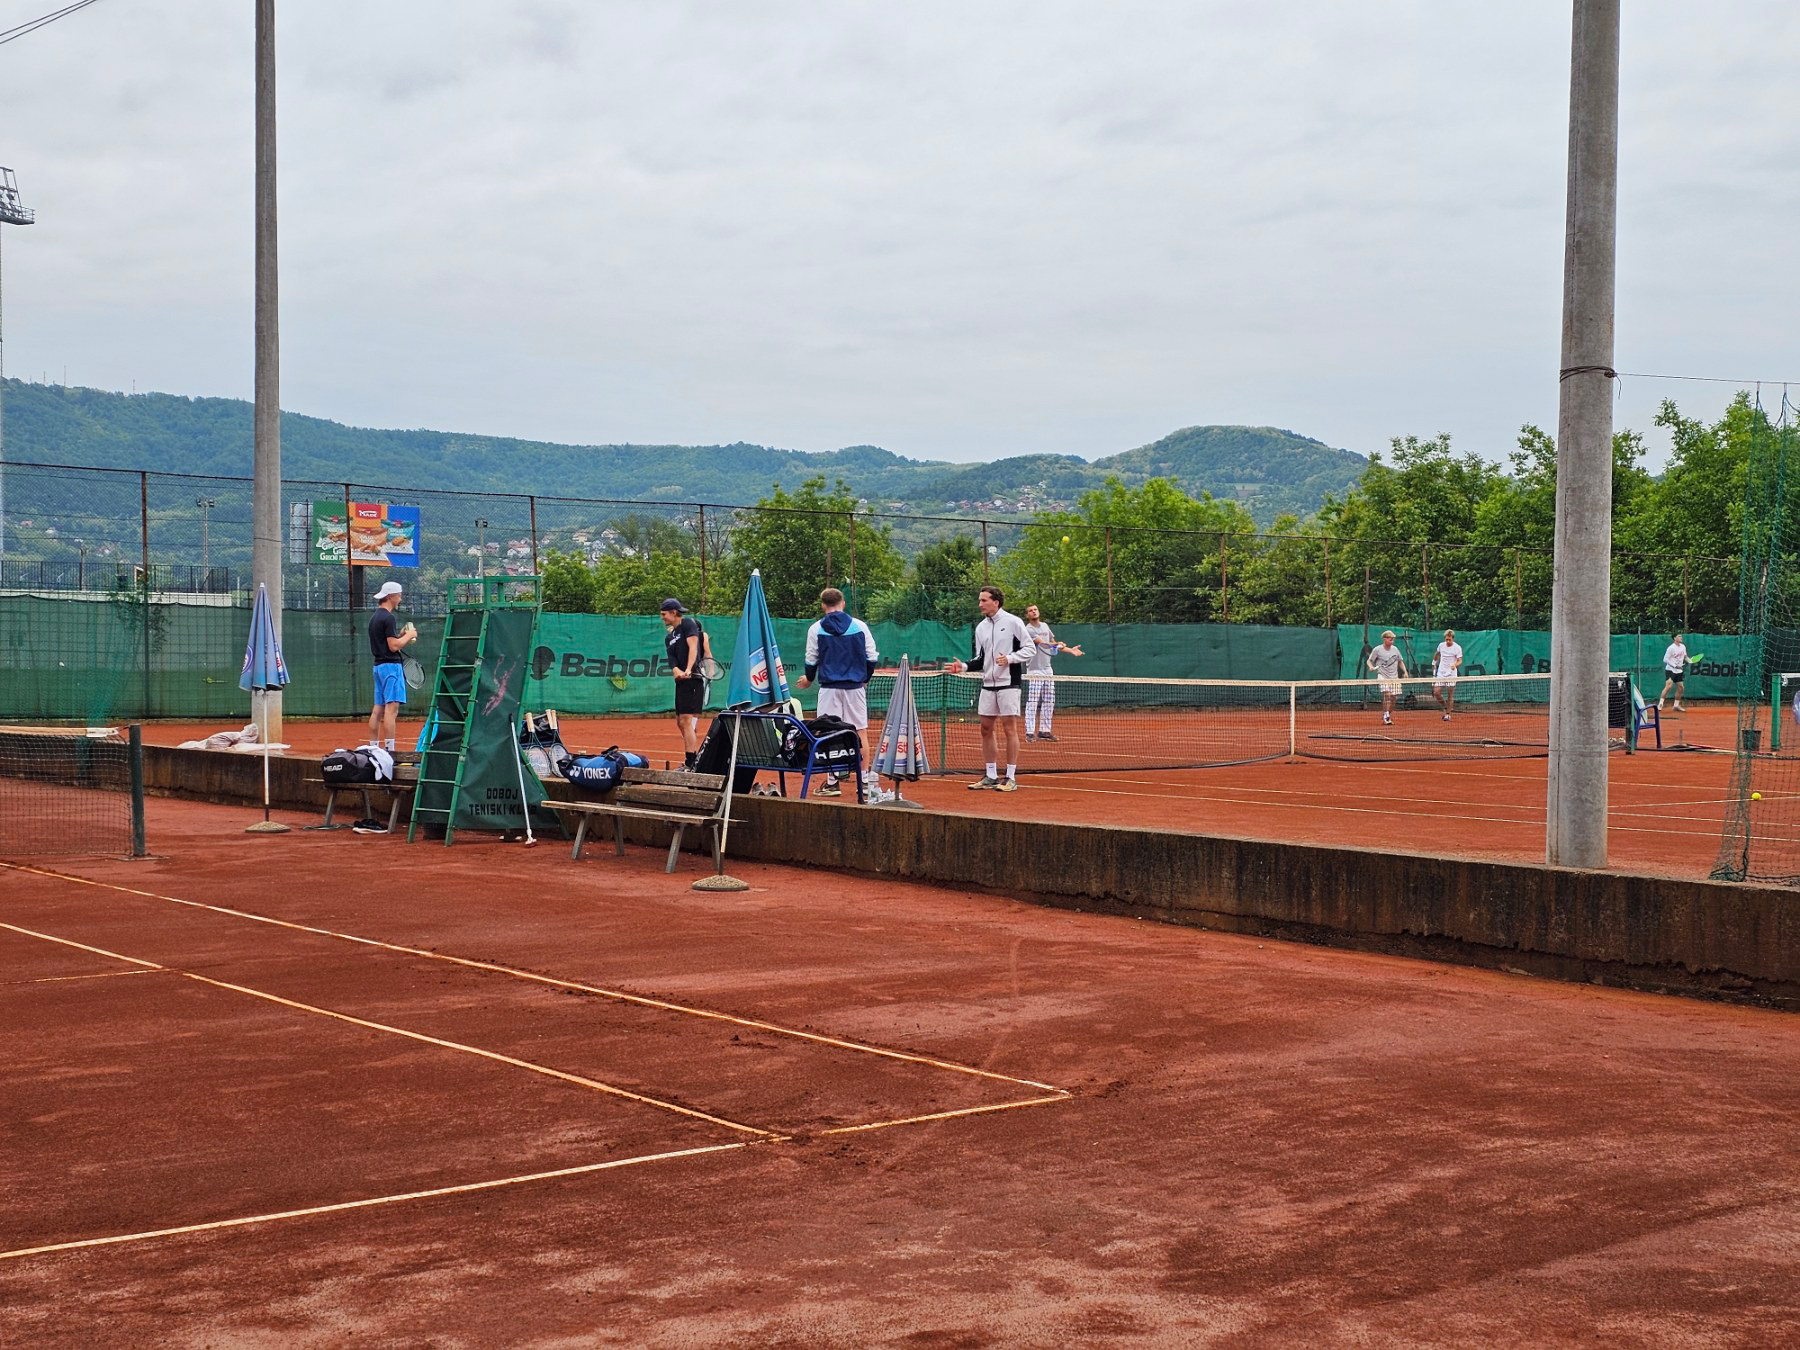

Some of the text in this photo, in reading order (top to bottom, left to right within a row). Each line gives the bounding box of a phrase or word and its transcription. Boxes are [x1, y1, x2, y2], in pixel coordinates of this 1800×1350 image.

[560, 653, 676, 678] Babola
[815, 748, 856, 760] HEAD
[323, 764, 343, 772] HEAD
[582, 767, 612, 780] YONEX
[486, 787, 519, 800] DOBOJ
[468, 803, 507, 816] TENISKI
